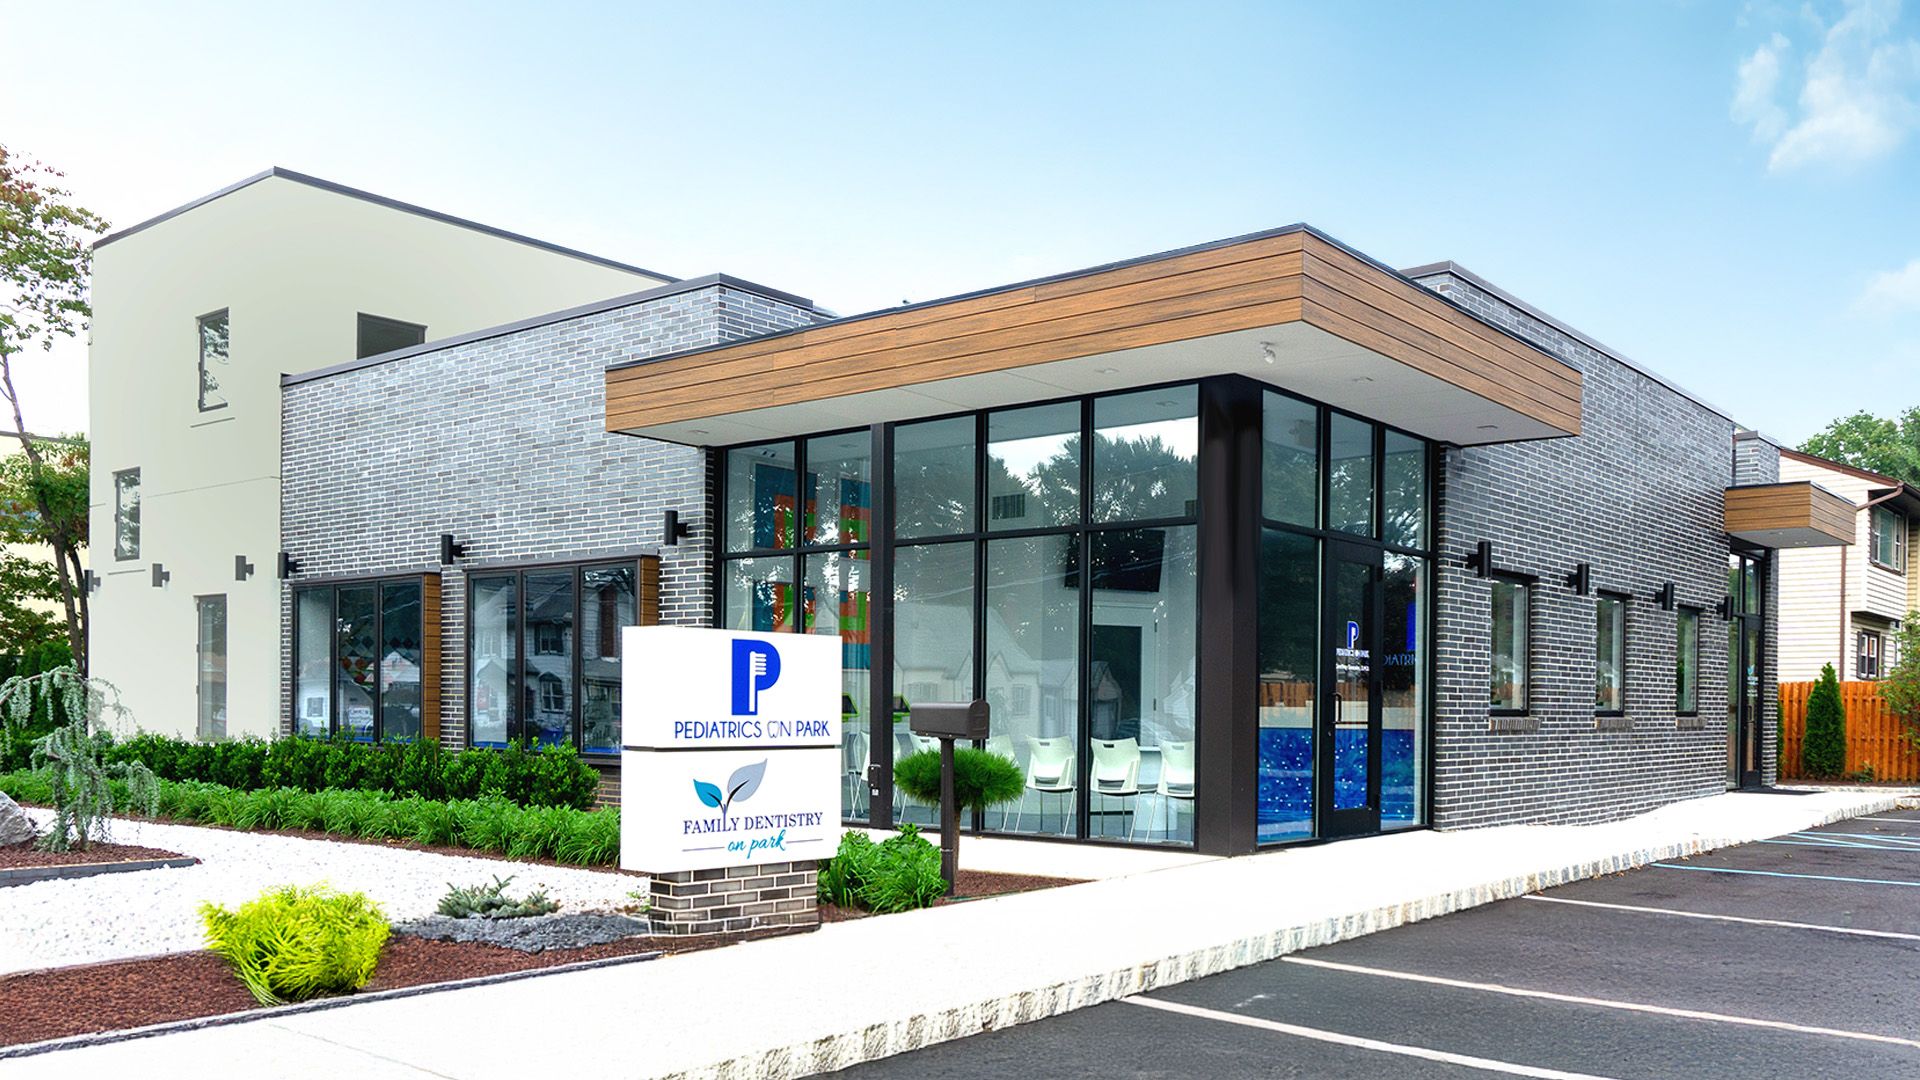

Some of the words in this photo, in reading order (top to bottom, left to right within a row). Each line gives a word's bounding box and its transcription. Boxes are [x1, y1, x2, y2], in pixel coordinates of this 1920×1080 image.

[731, 638, 781, 716] P
[674, 720, 762, 739] PEDIATRICS
[766, 720, 792, 738] ON
[796, 720, 831, 737] PARK
[683, 804, 740, 835] FAMILY
[744, 811, 823, 831] DENTISTRY
[727, 840, 747, 852] on
[747, 829, 786, 859] park
